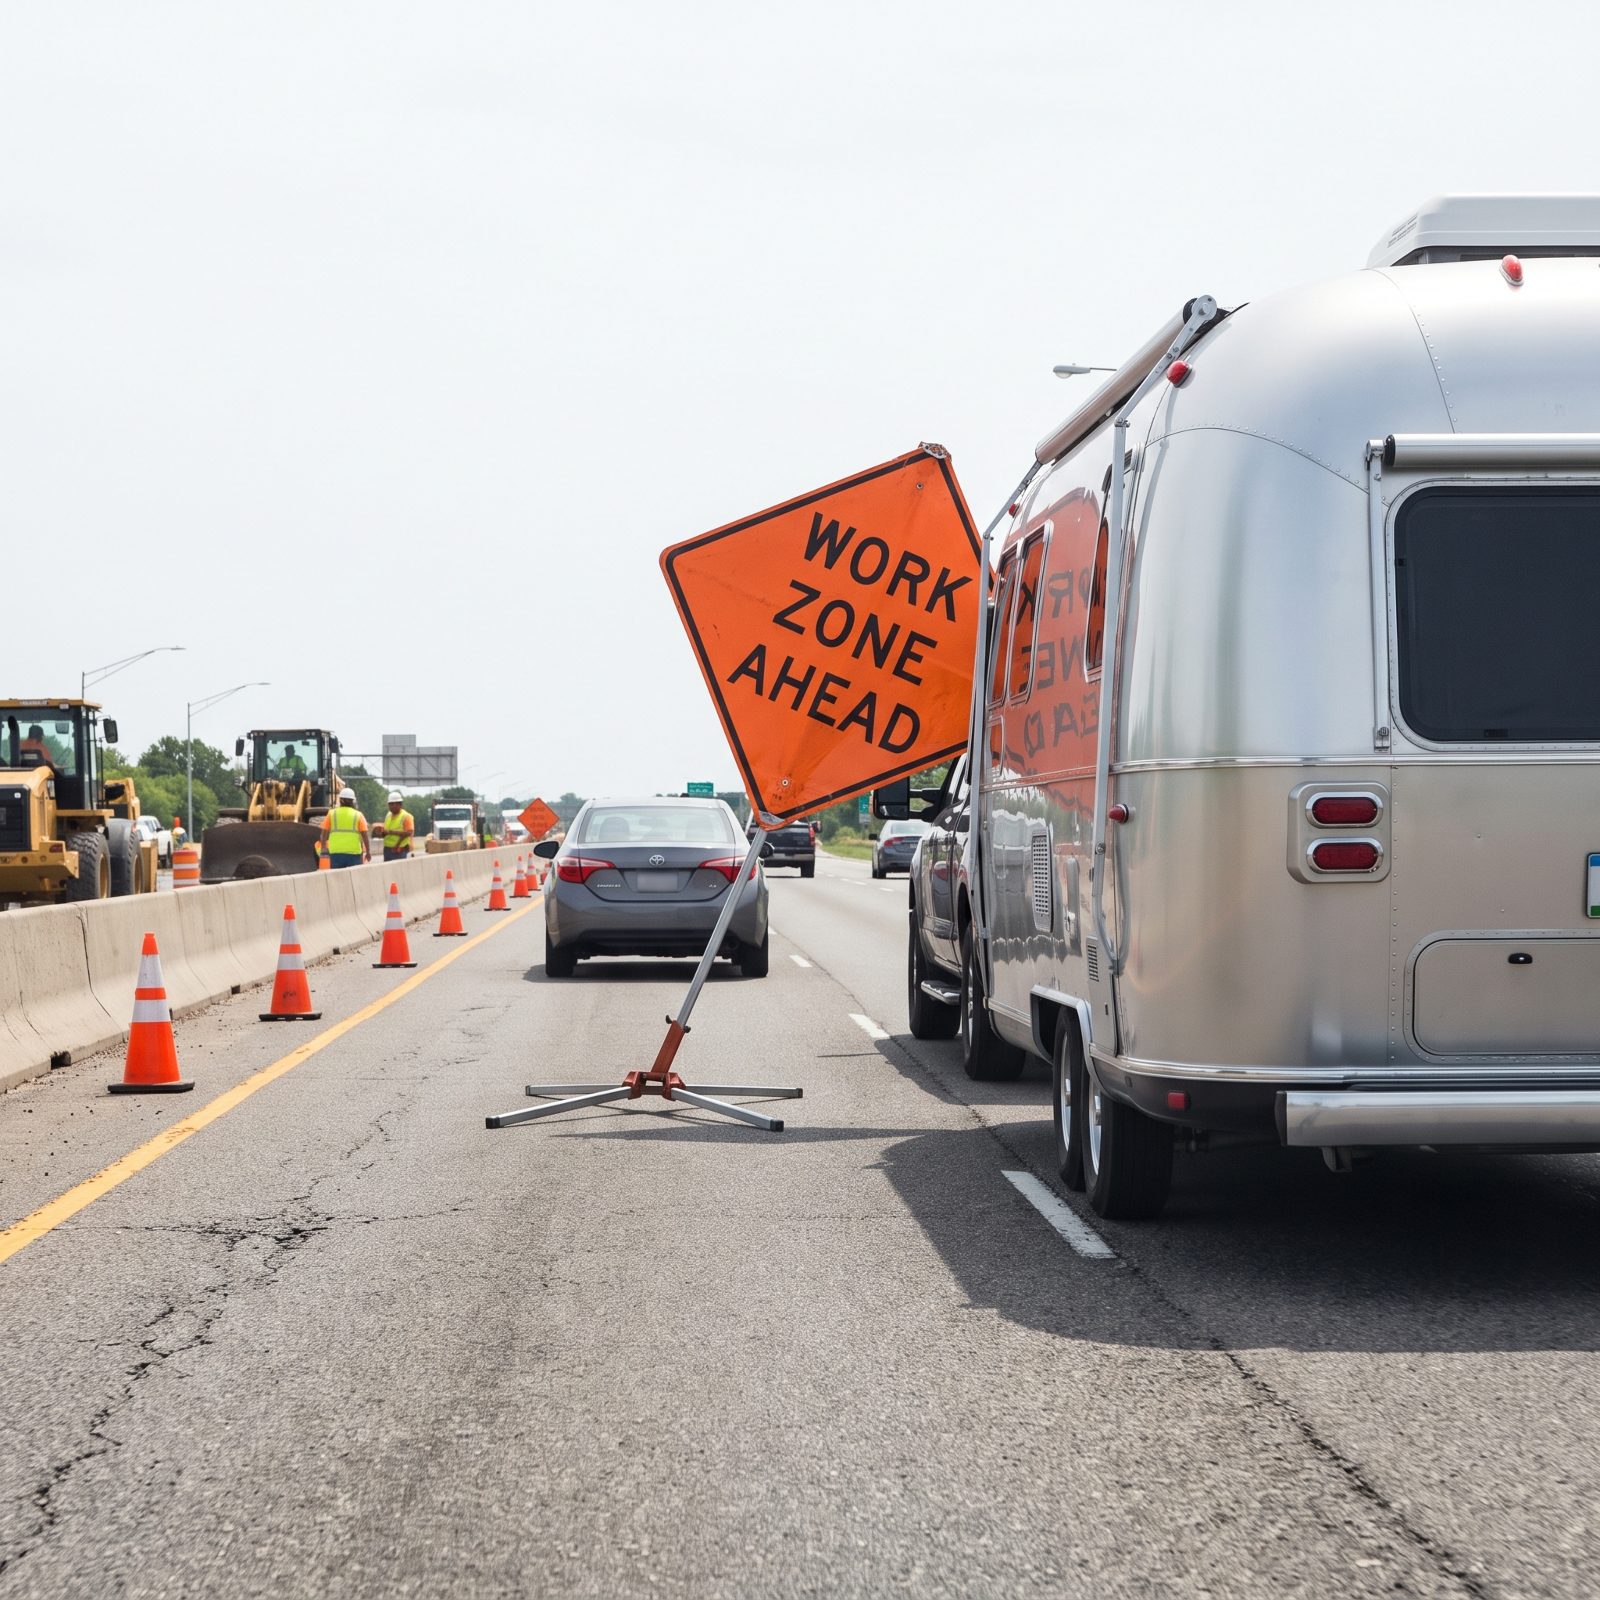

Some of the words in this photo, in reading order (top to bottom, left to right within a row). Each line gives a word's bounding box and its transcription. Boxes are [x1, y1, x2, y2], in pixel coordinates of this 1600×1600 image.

[804, 511, 973, 623] WORK
[773, 579, 938, 686] ZONE
[727, 643, 921, 754] AHEAD
